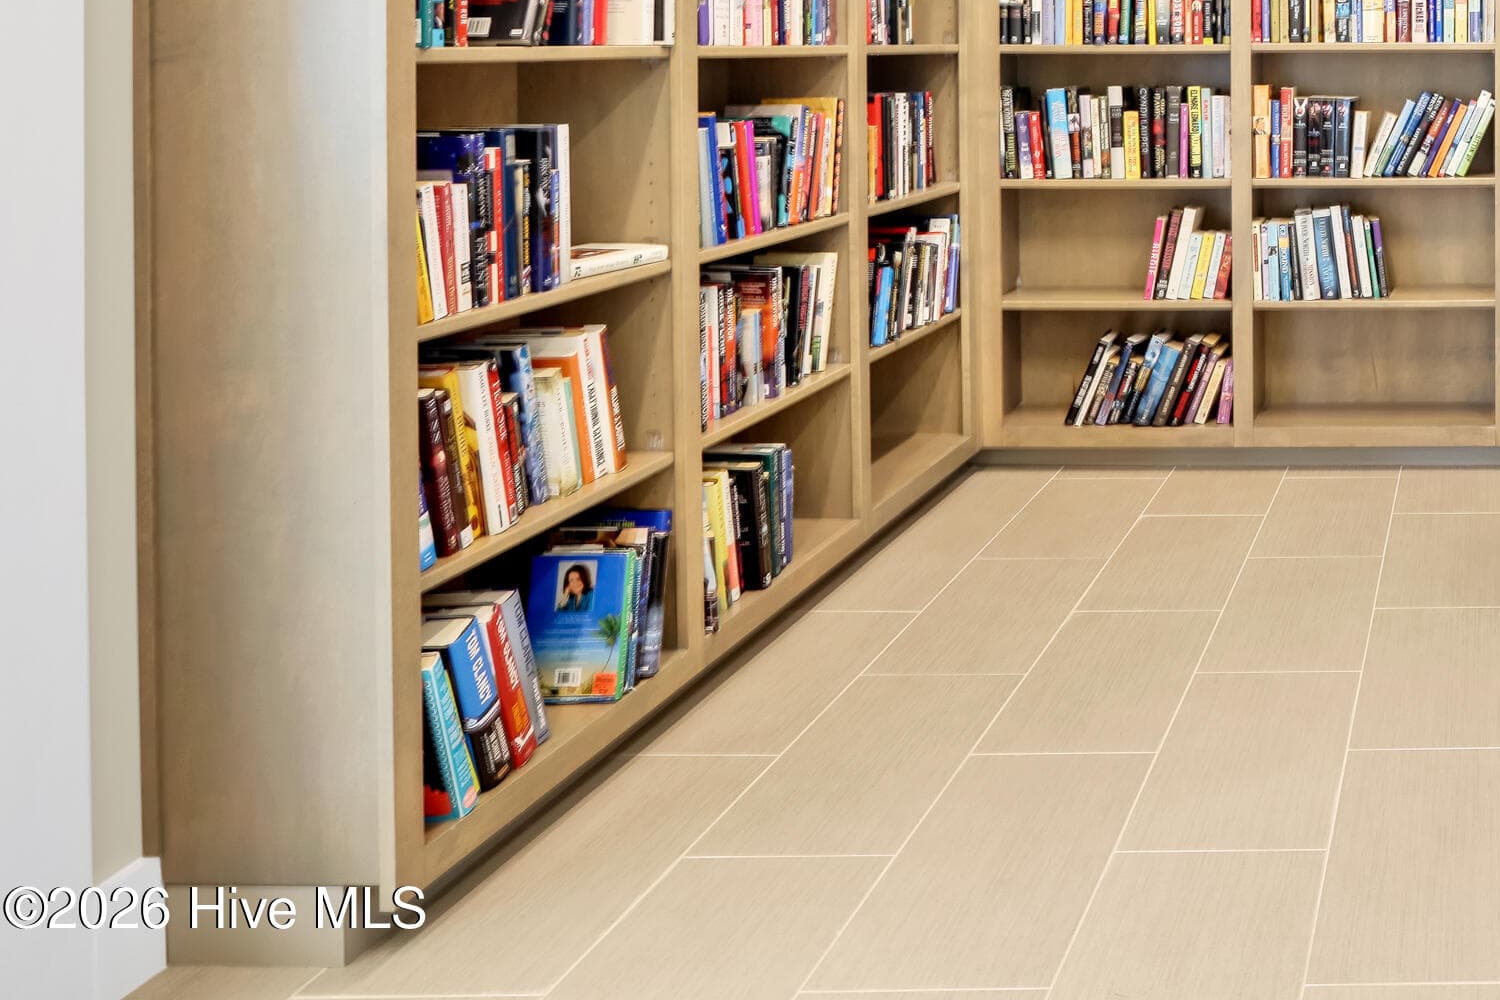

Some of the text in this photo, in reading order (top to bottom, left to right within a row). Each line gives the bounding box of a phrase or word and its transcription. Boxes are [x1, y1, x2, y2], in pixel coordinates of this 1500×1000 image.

[1415, 2, 1424, 23] McNAB
[1140, 88, 1149, 153] CYNDI LAUPER
[1190, 90, 1199, 134] ELMORE LEONARD
[465, 628, 492, 706] TOM CLANCY
[496, 614, 508, 643] TOM
[502, 642, 520, 690] CLANCY
[512, 600, 523, 628] TOM
[519, 627, 536, 678] CLANCY
